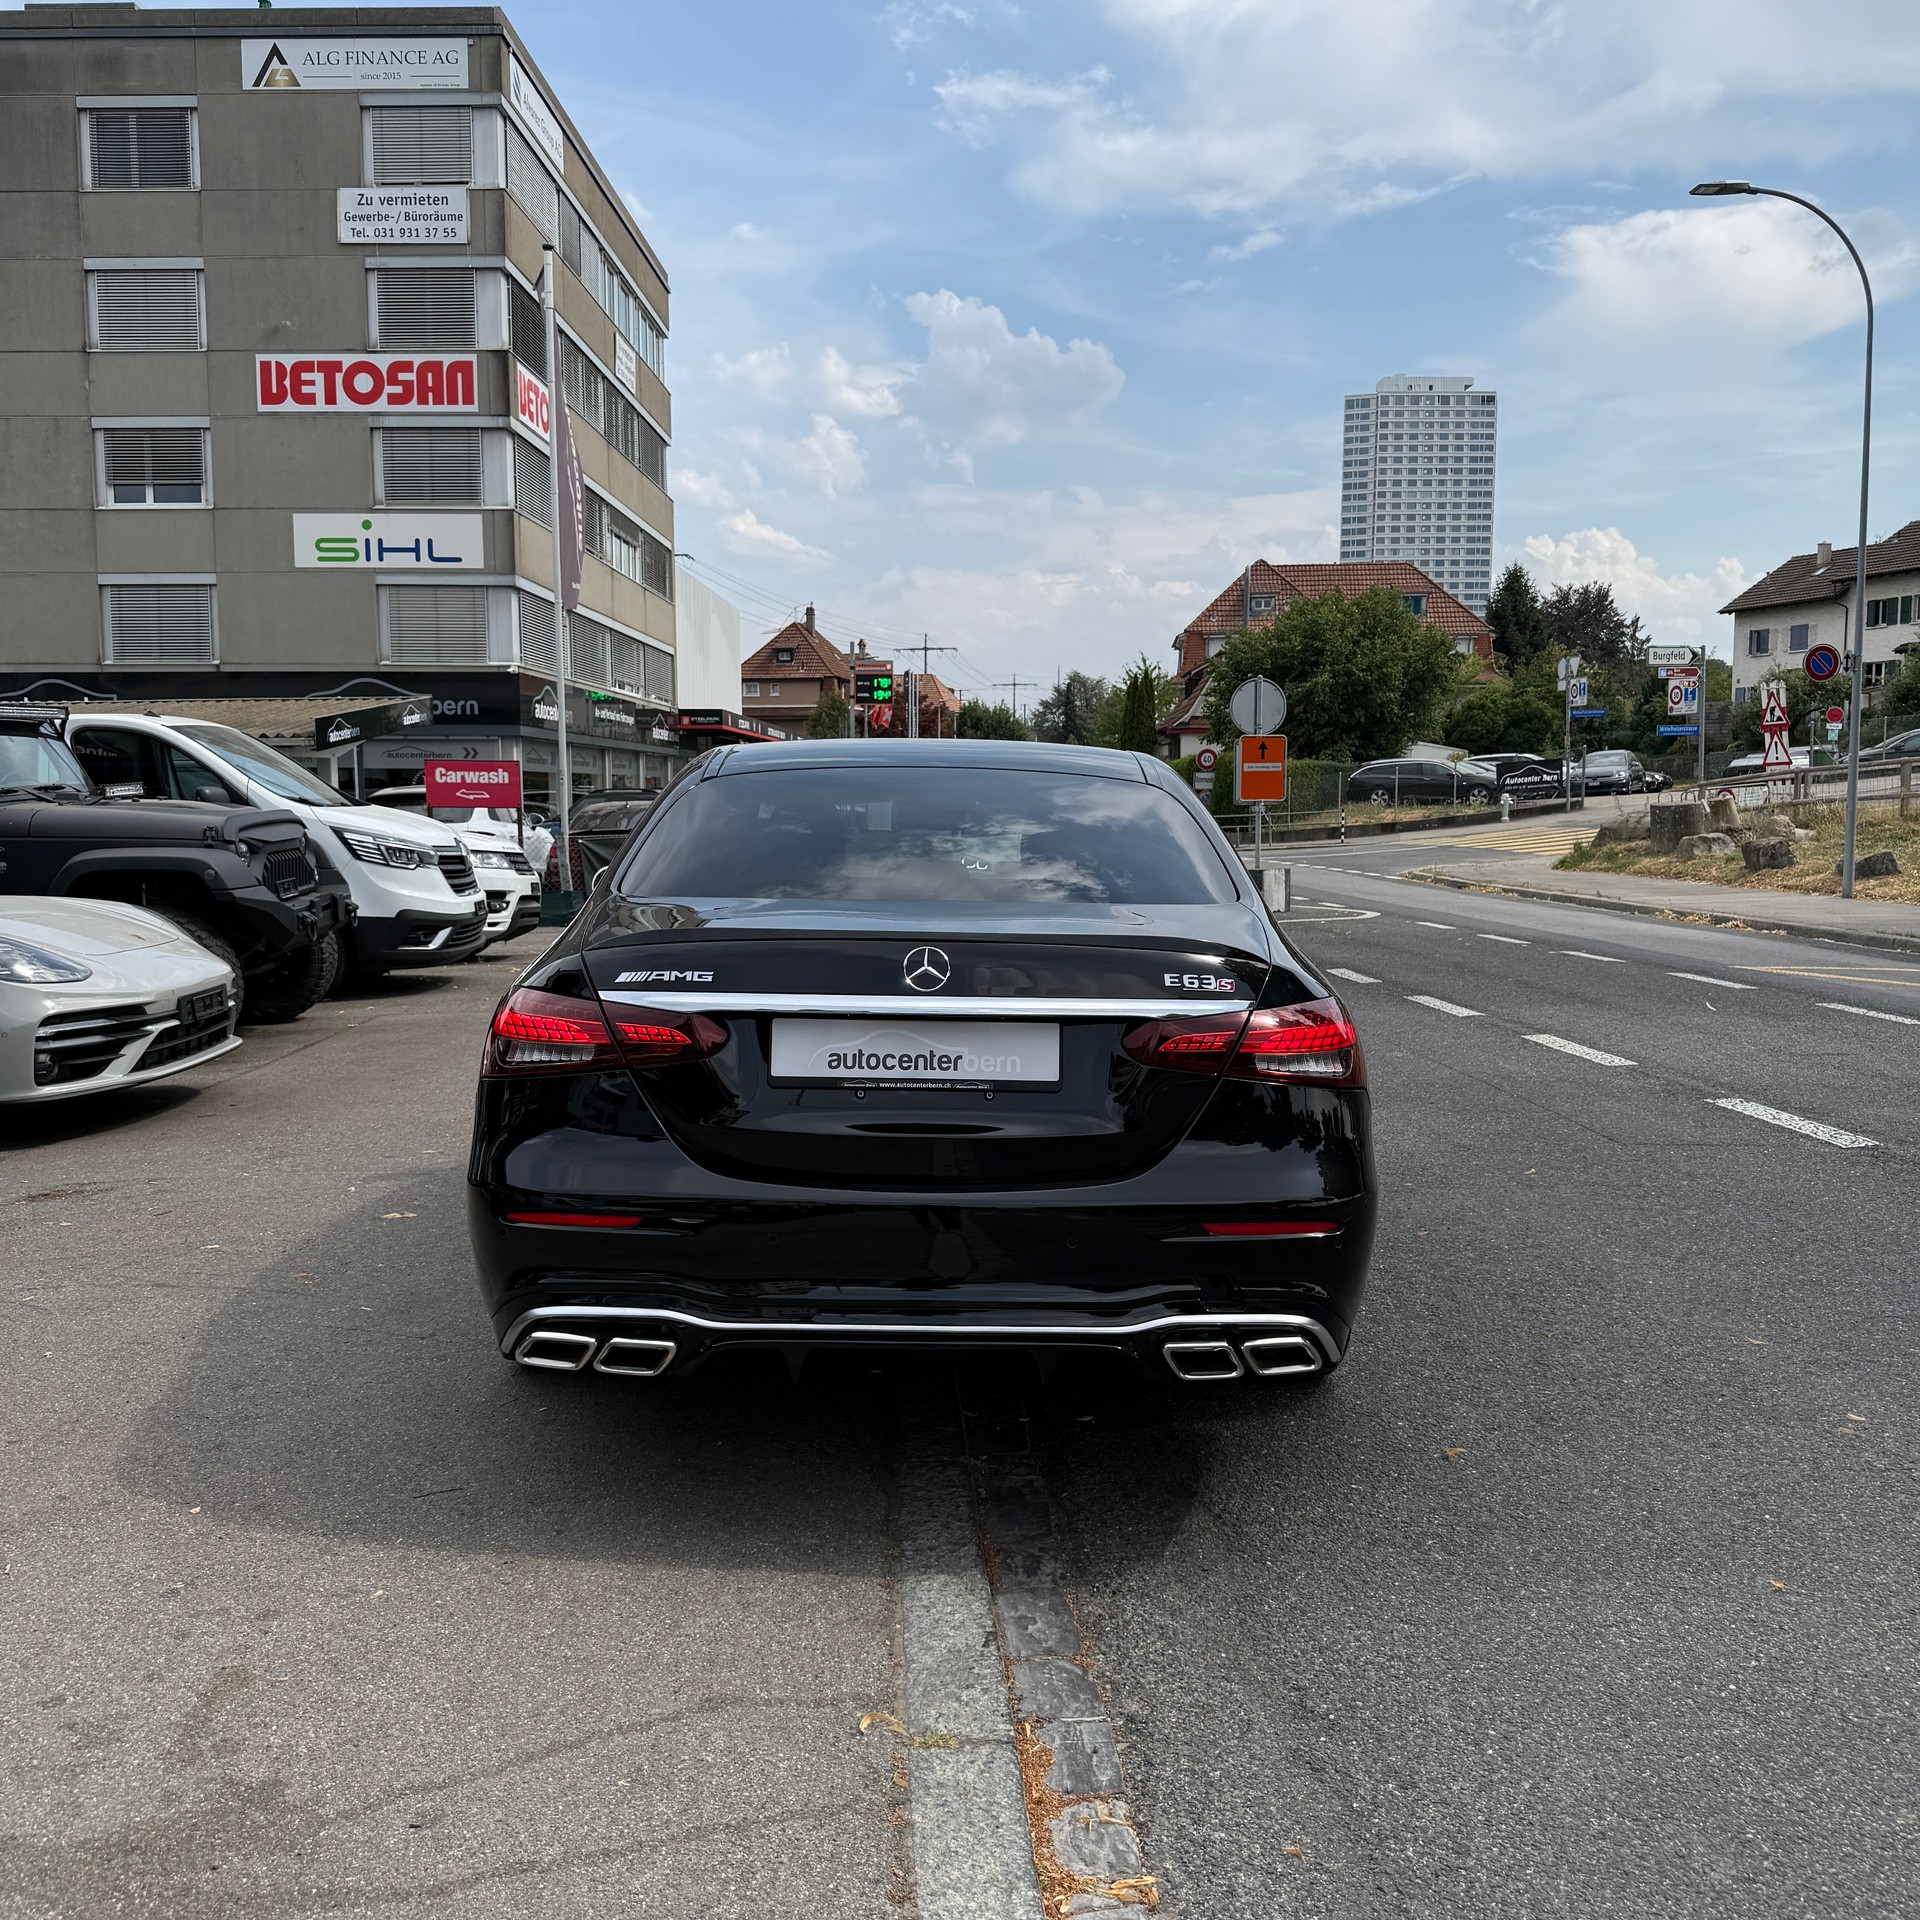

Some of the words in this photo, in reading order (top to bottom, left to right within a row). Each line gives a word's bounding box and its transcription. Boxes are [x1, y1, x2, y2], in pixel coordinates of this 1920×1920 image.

[303, 51, 340, 66] ALG
[345, 50, 428, 66] FINANCE
[432, 50, 459, 65] AG
[360, 72, 381, 80] since
[382, 72, 402, 80] 2015
[522, 91, 541, 128] Alvarez
[540, 117, 555, 151] Group
[554, 137, 562, 159] AG
[357, 193, 373, 206] Zu
[379, 193, 449, 206] vermieten
[404, 210, 464, 222] Büroräume
[350, 227, 370, 238] Tel.
[373, 227, 395, 238] 031
[399, 227, 420, 238] 931
[424, 227, 438, 238] 37
[443, 227, 457, 238] 55
[259, 360, 475, 406] BETOSAN
[1652, 651, 1686, 662] Burgfeld
[386, 751, 453, 760] autocenterbern
[1202, 755, 1212, 764] 40
[434, 767, 509, 784] Carwash
[1505, 775, 1543, 785] Autocenter
[1542, 774, 1558, 782] Bern
[646, 970, 714, 982] AMG
[879, 1081, 951, 1089] www.autocenterbern.ch
